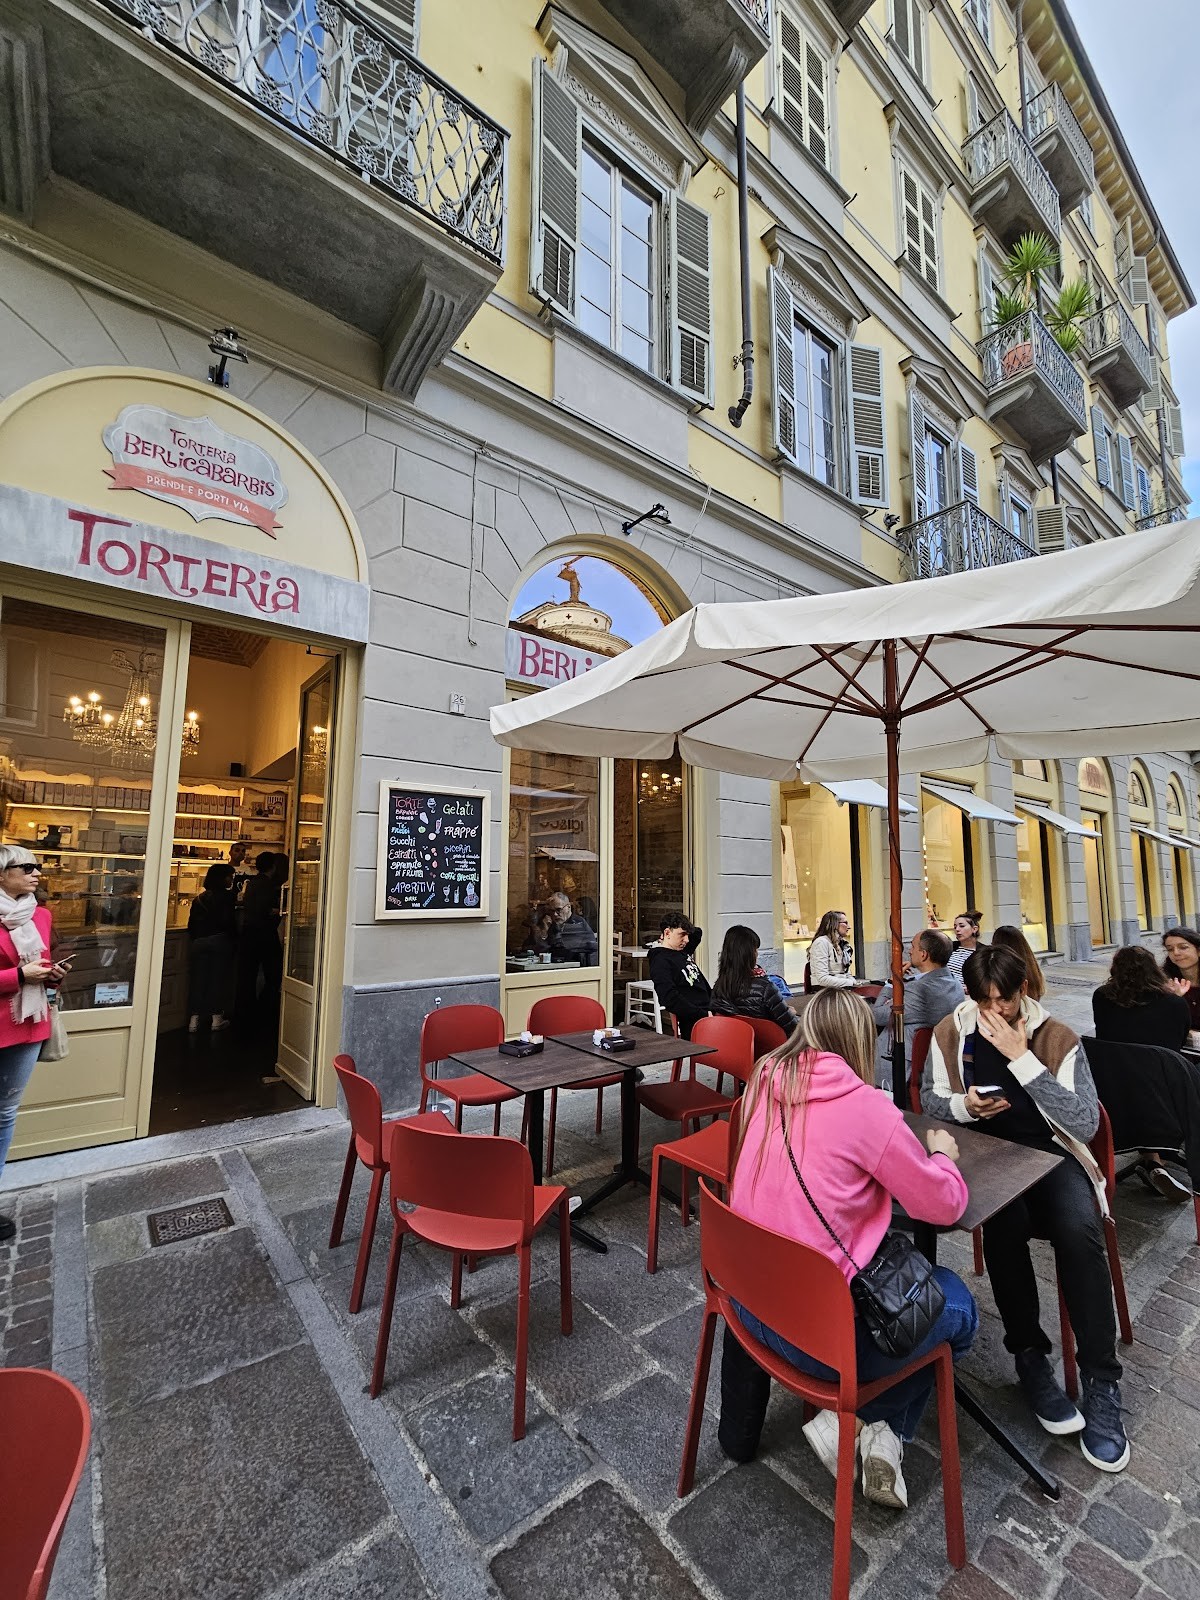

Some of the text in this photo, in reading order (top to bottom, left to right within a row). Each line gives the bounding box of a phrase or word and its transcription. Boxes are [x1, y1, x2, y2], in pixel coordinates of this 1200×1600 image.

[146, 475, 251, 514] PRENDI E PORTI VIA
[453, 693, 465, 704] 26
[391, 795, 424, 810] TORTE
